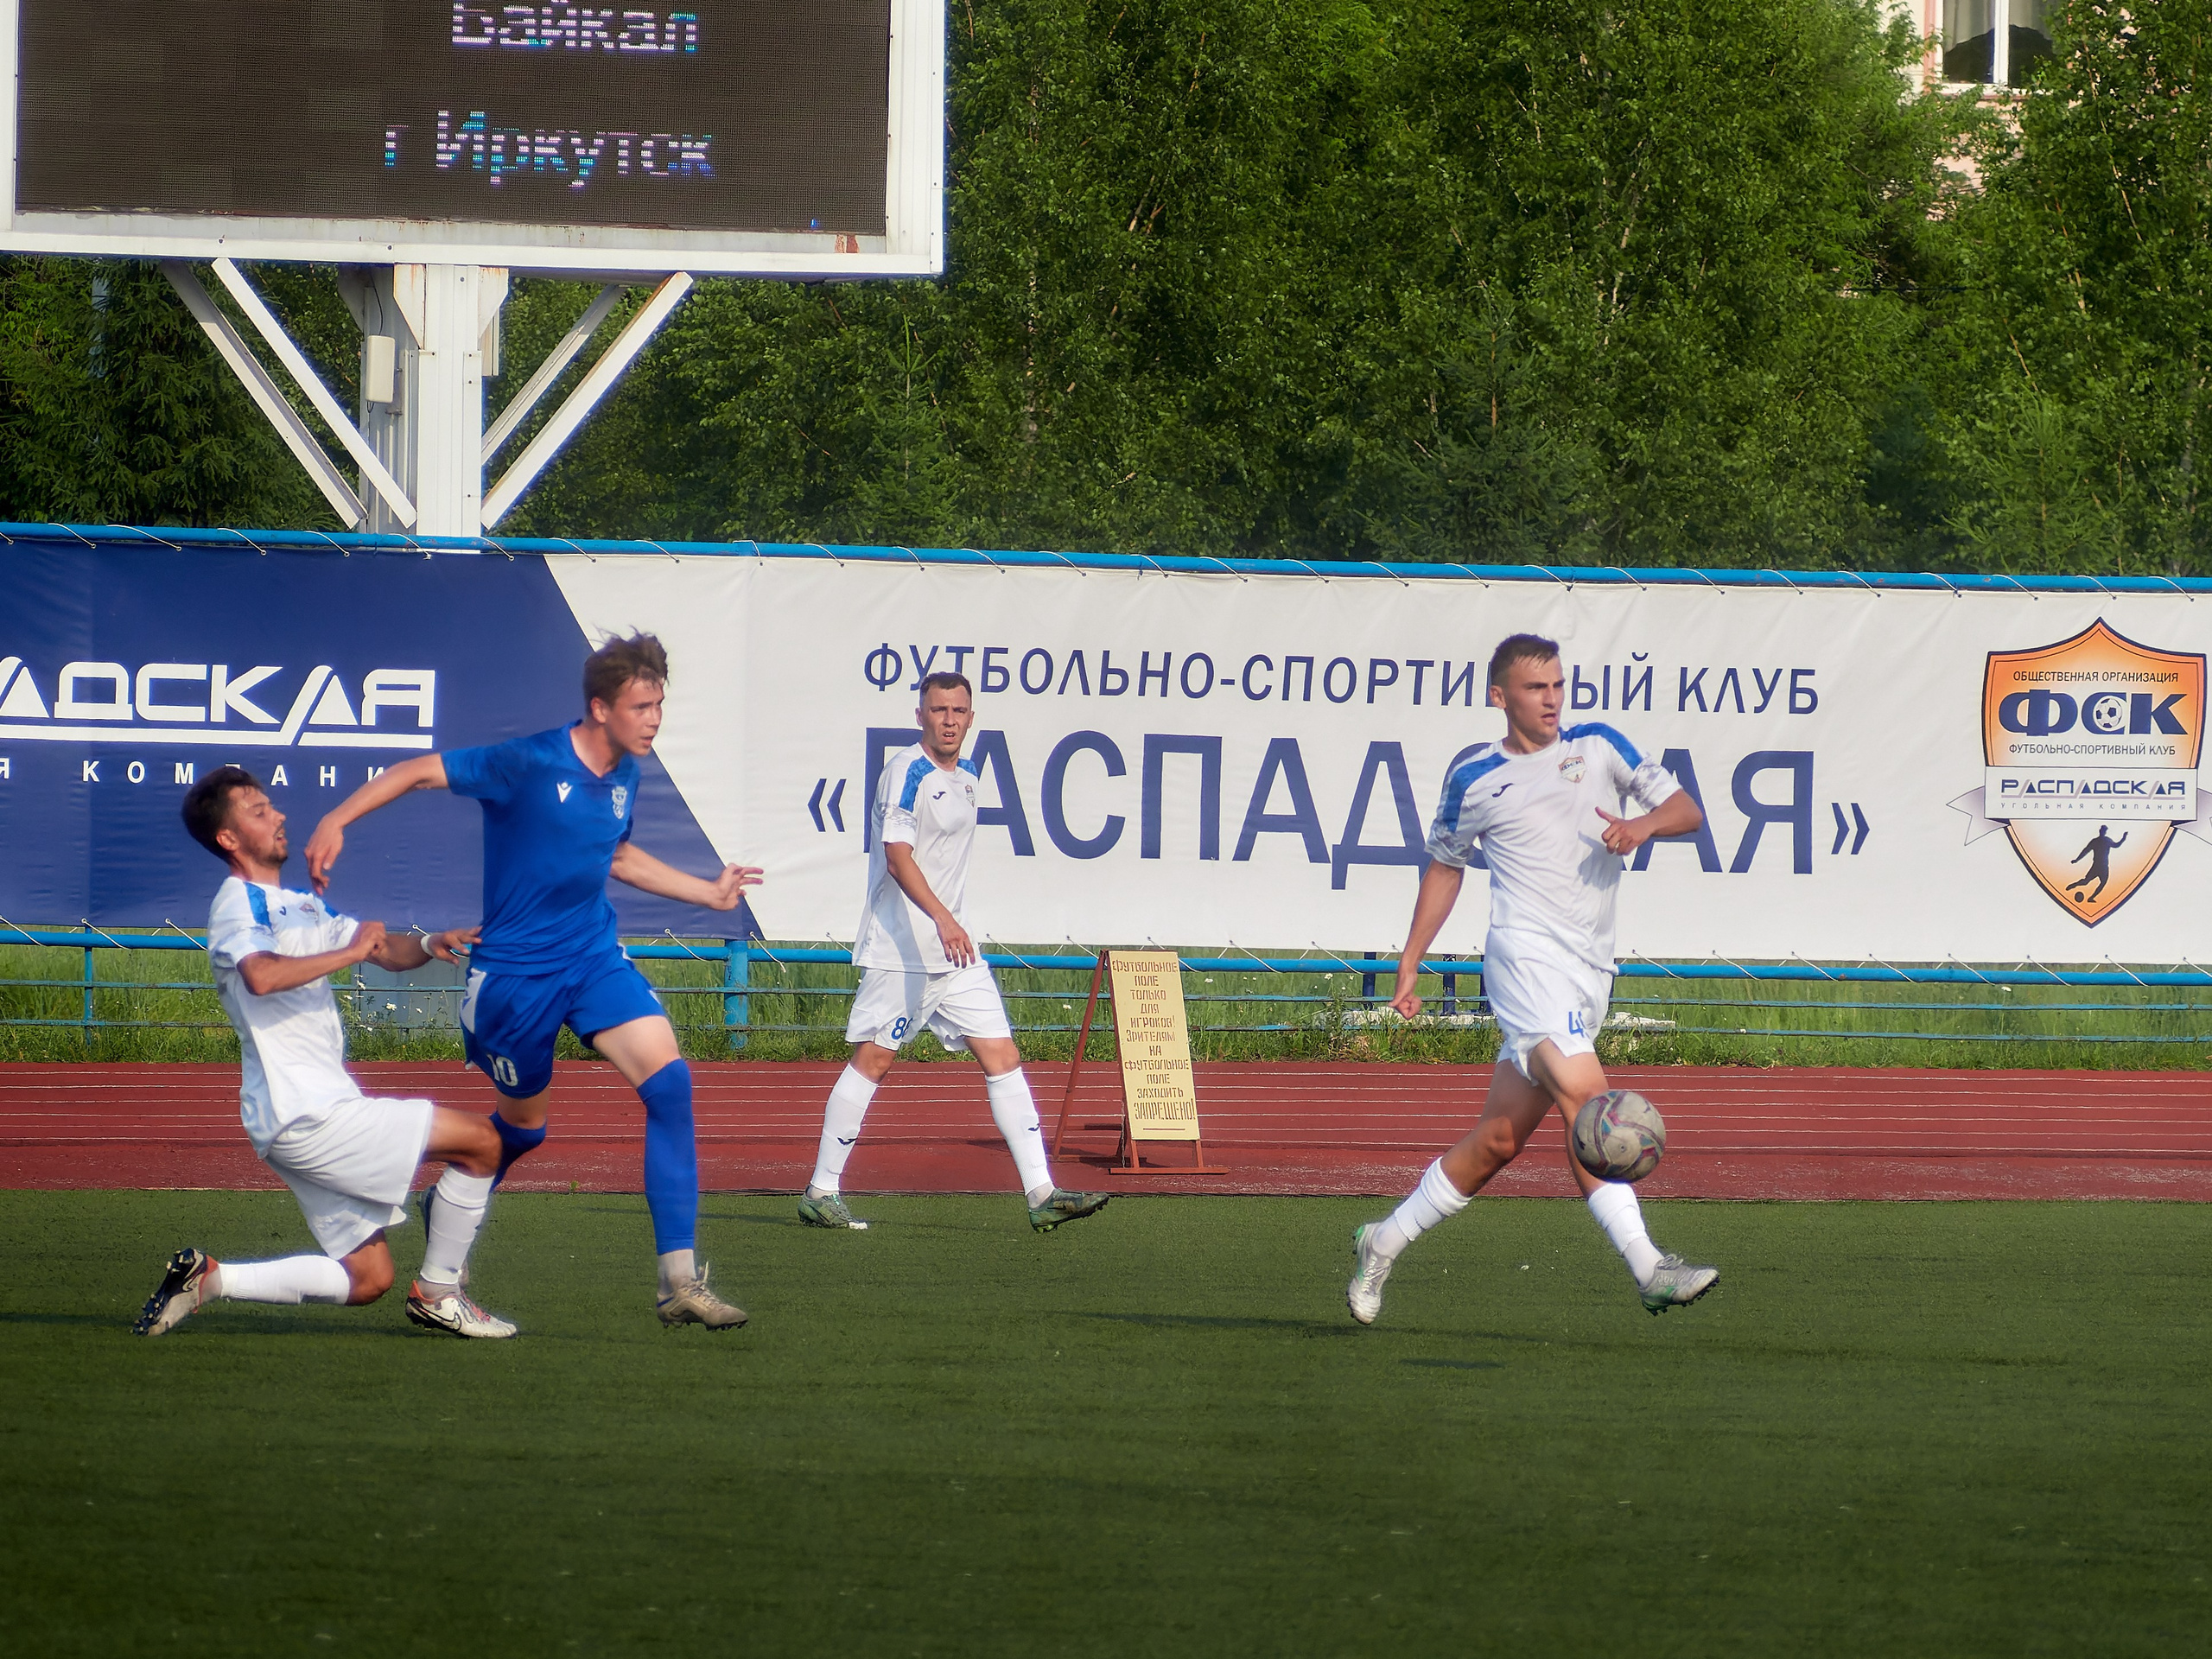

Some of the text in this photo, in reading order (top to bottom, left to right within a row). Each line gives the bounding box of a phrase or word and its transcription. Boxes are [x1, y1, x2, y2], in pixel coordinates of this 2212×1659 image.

[435, 110, 716, 188] Иркутск
[864, 642, 1819, 715] ФУТБОЛЬНО-СПОРТИЫЙ КЛУБ
[2012, 671, 2179, 683] ОБЩЕСТВЕННАЯ ОРГАНИЗАЦИЯ
[1999, 689, 2189, 737] ФСК
[2009, 742, 2176, 756] ФУТБОЛЬНО-СПОРТИВНЫЙ КЛУБ
[2001, 779, 2185, 796] РАСПАДСКАЯ
[1112, 959, 1179, 973] ФУТБОЛЬНОЕ
[1134, 976, 1160, 987] ПОЛЕ
[1130, 989, 1166, 1001] ТОЛЬКО
[1140, 1003, 1160, 1014] ДЛЯ
[1130, 1014, 1176, 1028] ИГРОКОВ!
[1148, 1045, 1162, 1056] НА
[486, 1052, 519, 1088] 10
[1124, 1058, 1190, 1071] ФУТБОЛЬНОЕ
[1146, 1073, 1171, 1084] ПОЛЕ
[1136, 1087, 1184, 1099] ЗАХОДИТЬ
[1133, 1097, 1196, 1121] ЗАПРЕЩЕНО!
